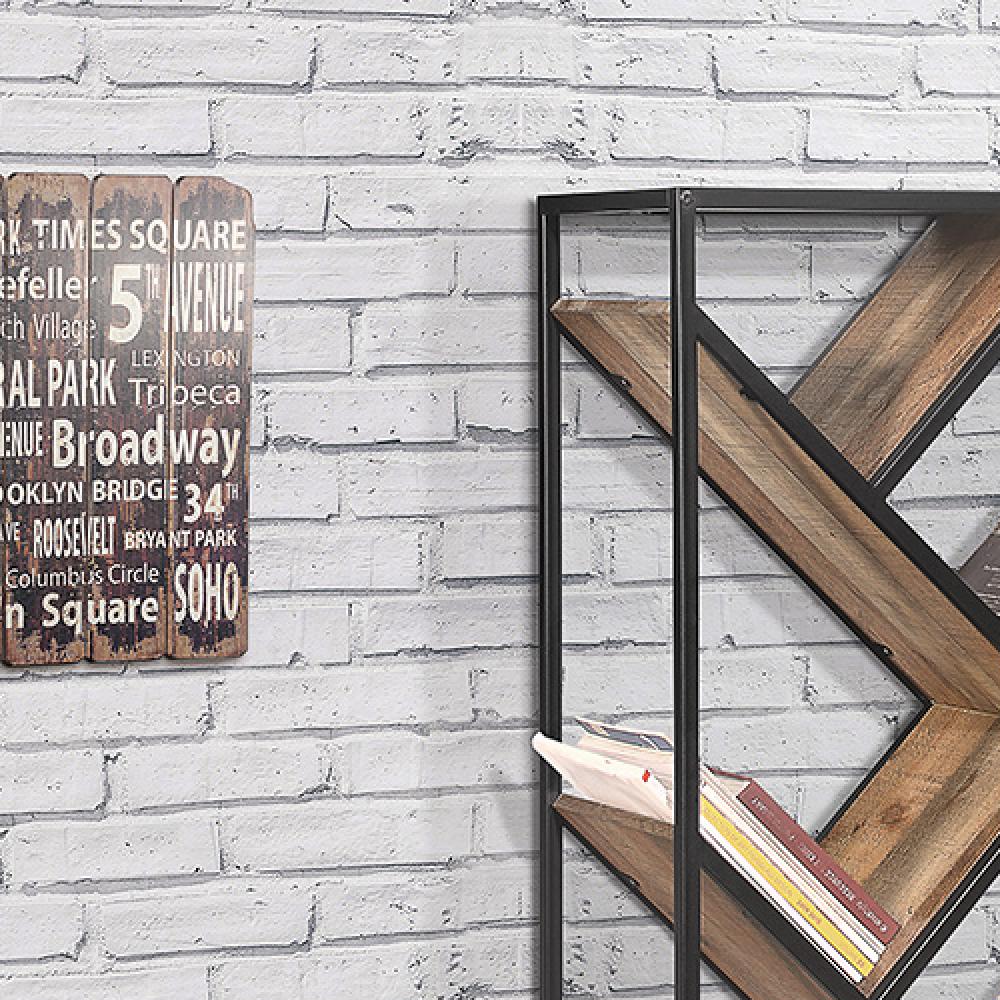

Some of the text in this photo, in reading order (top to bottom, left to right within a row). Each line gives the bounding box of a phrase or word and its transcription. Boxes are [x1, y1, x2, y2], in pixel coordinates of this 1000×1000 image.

[32, 219, 122, 249] TIMES
[129, 219, 247, 253] SQUARE
[164, 261, 245, 333] AVENUE
[33, 312, 97, 347] Village
[131, 349, 242, 367] LEXINGTON
[48, 358, 117, 407] PARK
[128, 377, 242, 406] Tribeca
[52, 414, 242, 478] Broadway
[92, 479, 179, 502] BRIDGE
[33, 514, 117, 559] ROOSEVELT
[124, 528, 238, 551] BRYANT PARK
[5, 563, 160, 590] Columbus Circle
[175, 561, 240, 625] SOHO
[41, 592, 159, 635] Square
